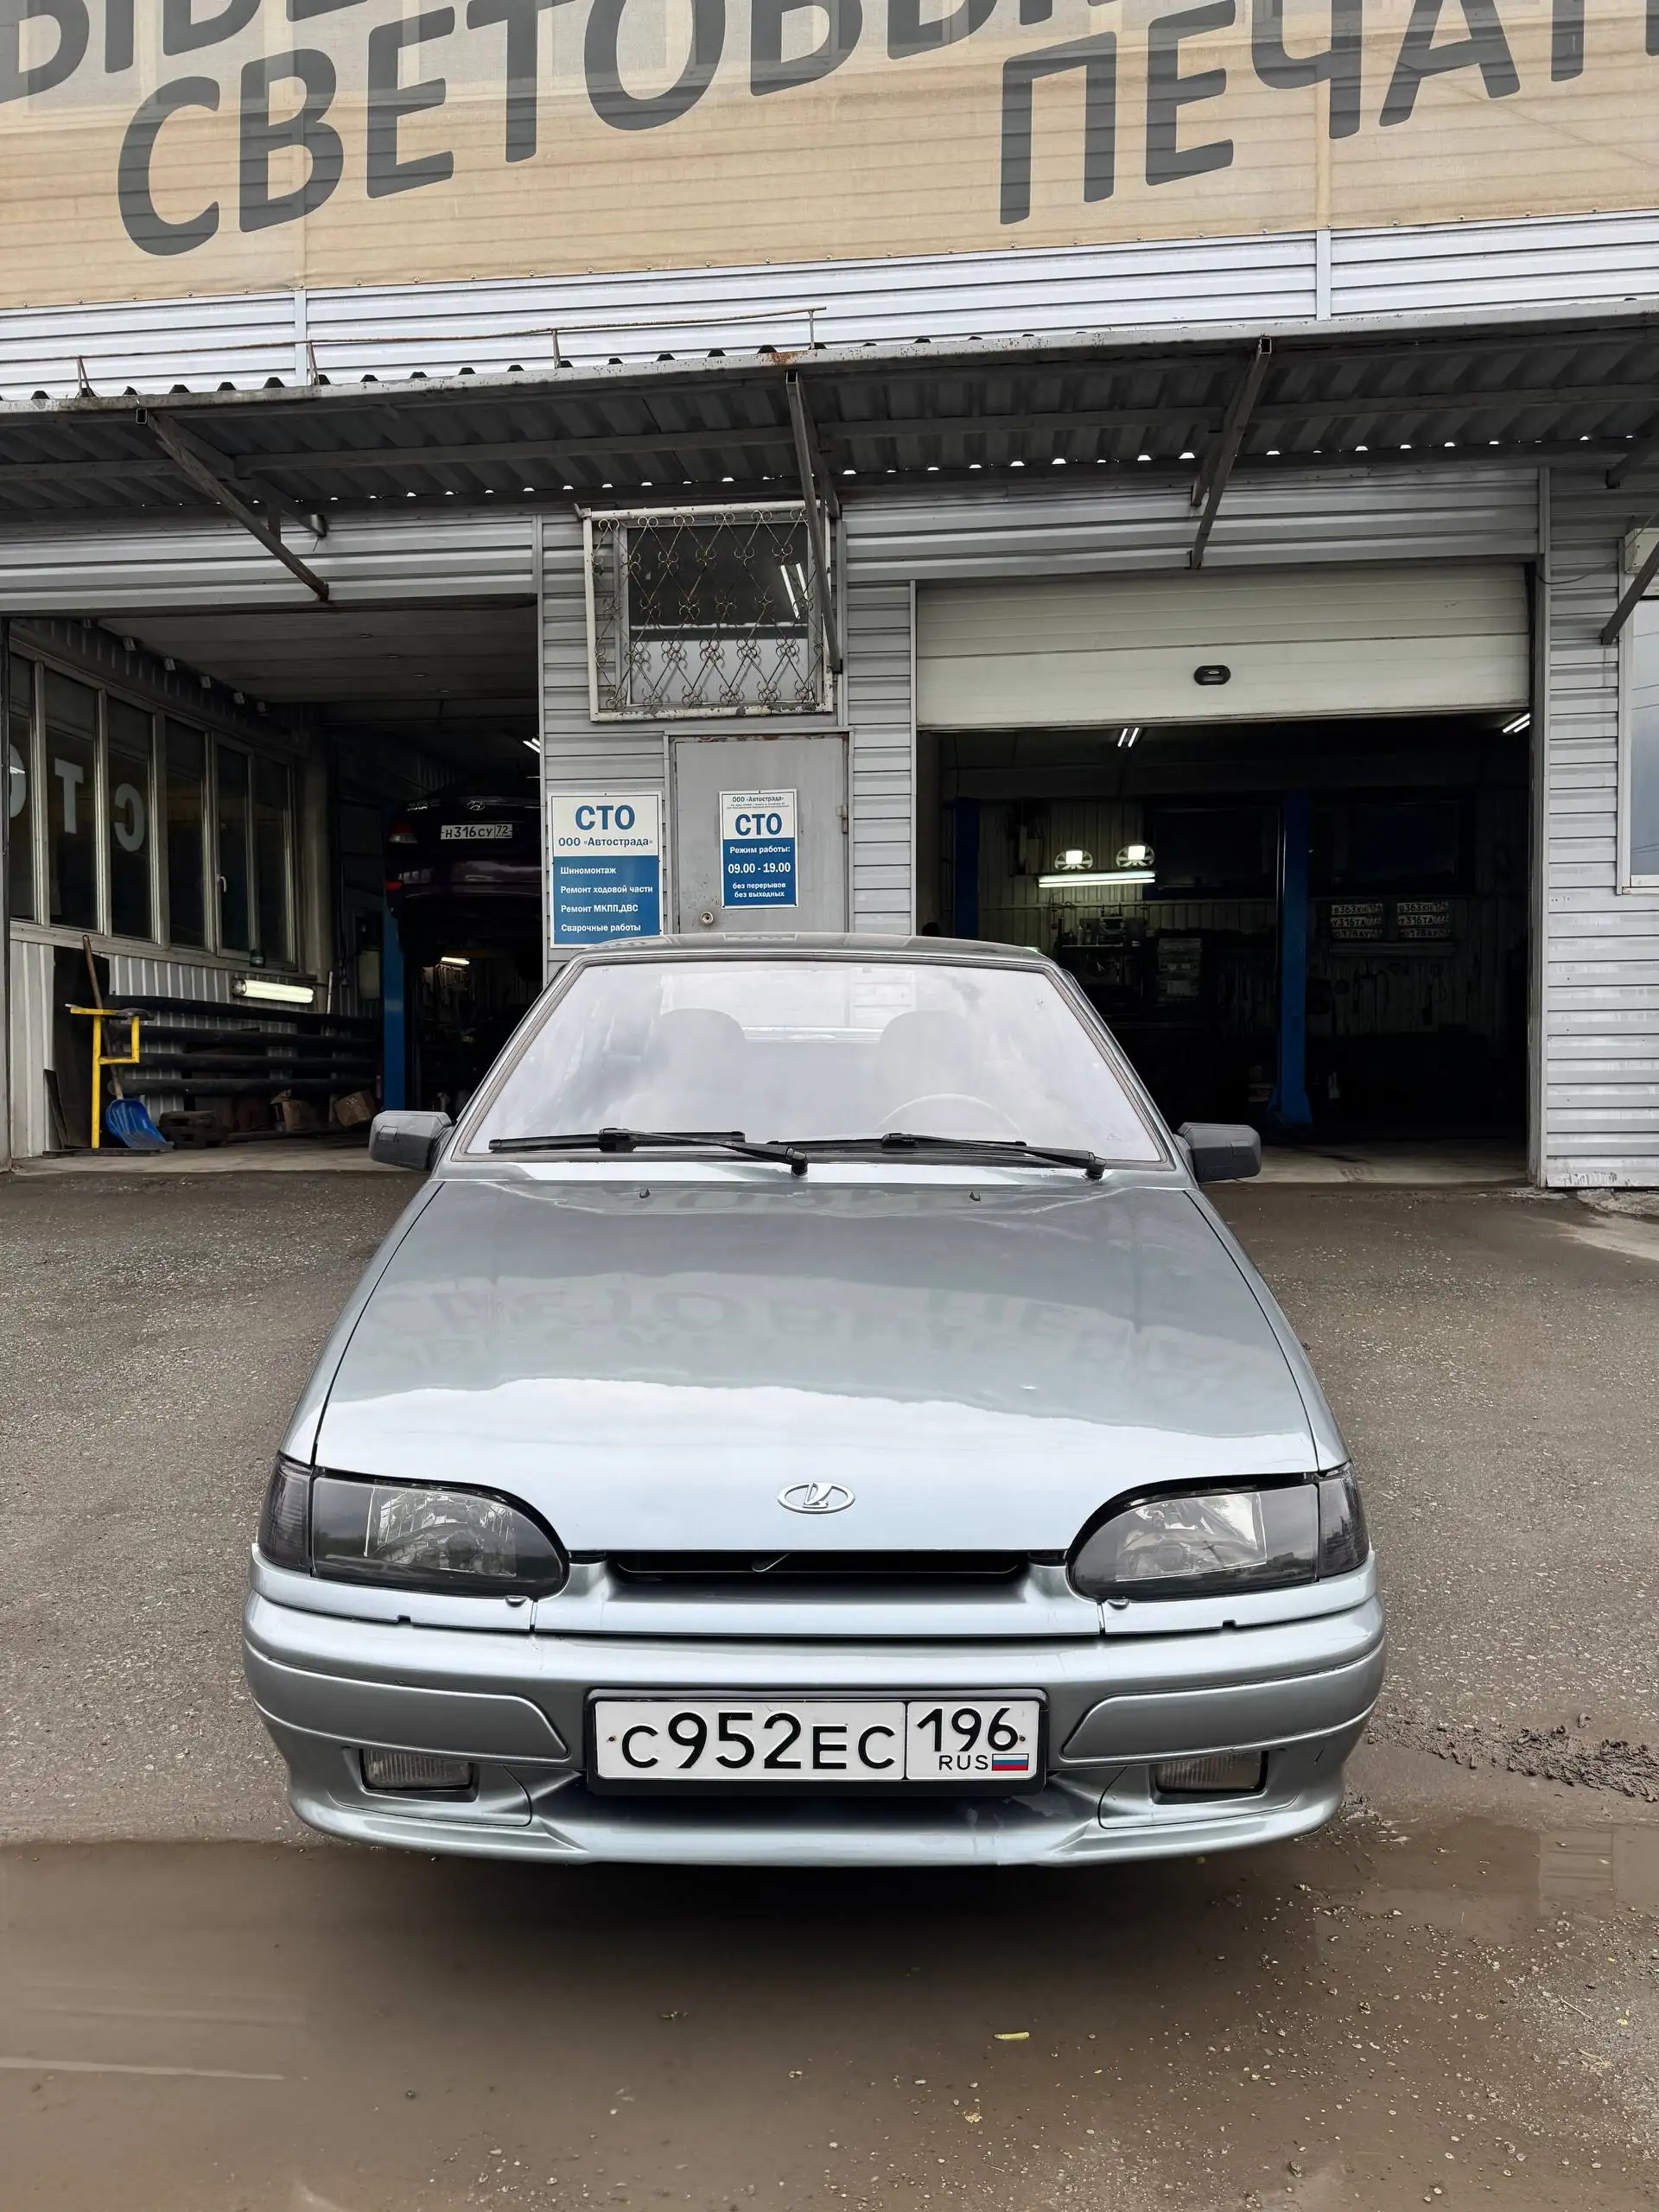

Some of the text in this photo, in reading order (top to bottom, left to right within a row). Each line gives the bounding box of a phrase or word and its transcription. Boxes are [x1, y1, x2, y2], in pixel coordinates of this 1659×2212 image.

[575, 804, 635, 830] СТО
[735, 813, 782, 836] СТО
[445, 825, 508, 838] Н316СУ 72
[558, 836, 653, 848] ООО «Автострада»
[759, 845, 791, 855] работы:
[728, 863, 755, 874] 09.00
[763, 862, 791, 873] 19.00
[594, 885, 627, 894] ходовой
[562, 923, 641, 932] Сварочные работы
[621, 1707, 1019, 1770] С952ЕС 196
[939, 1754, 988, 1771] RUS
